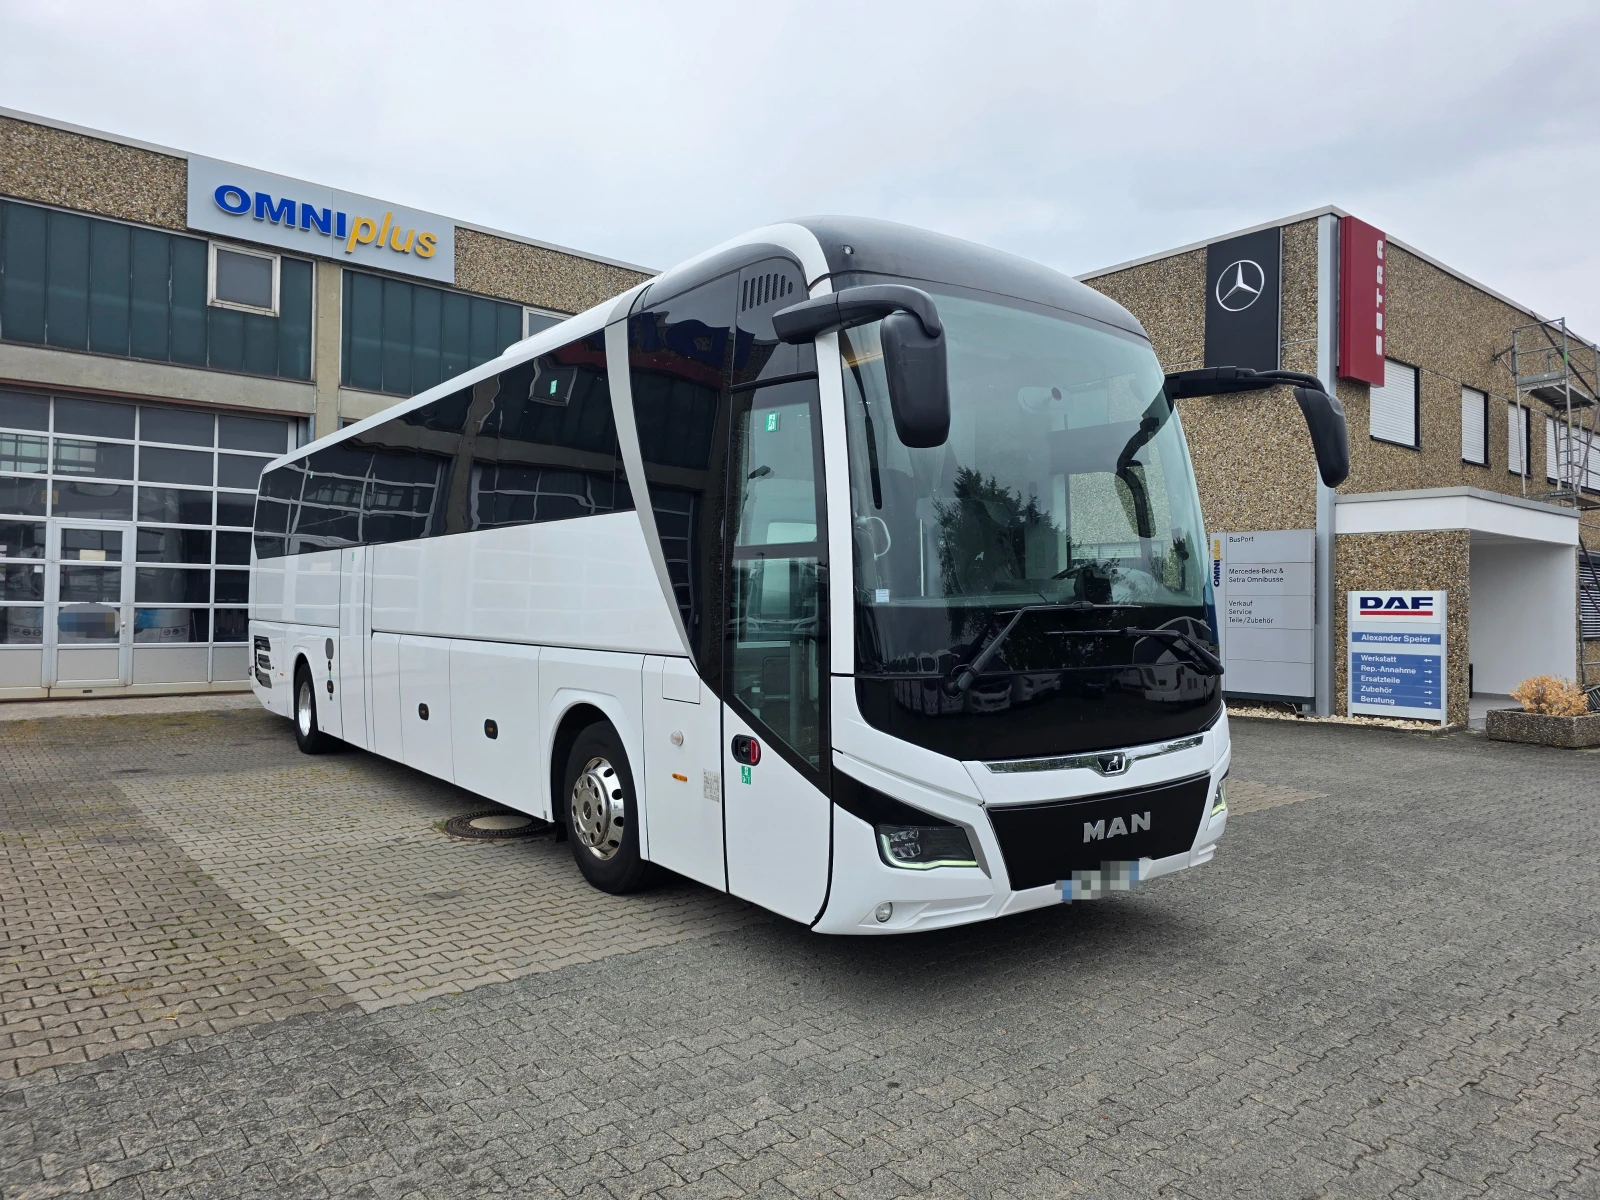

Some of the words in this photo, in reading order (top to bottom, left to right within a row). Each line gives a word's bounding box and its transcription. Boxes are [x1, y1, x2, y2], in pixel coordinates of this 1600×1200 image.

[214, 184, 438, 258] OMNIplus
[1212, 539, 1223, 587] OMNIplus
[1360, 597, 1433, 609] DAF
[1361, 634, 1401, 642] Alexander
[1403, 635, 1431, 644] Speier
[1361, 655, 1397, 663] Werkstatt
[1361, 665, 1417, 675] Rep.-Annahme
[1361, 675, 1401, 684] Ersatzteile
[1361, 685, 1393, 694] Zubehör
[1361, 696, 1395, 705] Beratung
[1083, 811, 1151, 843] MAN
